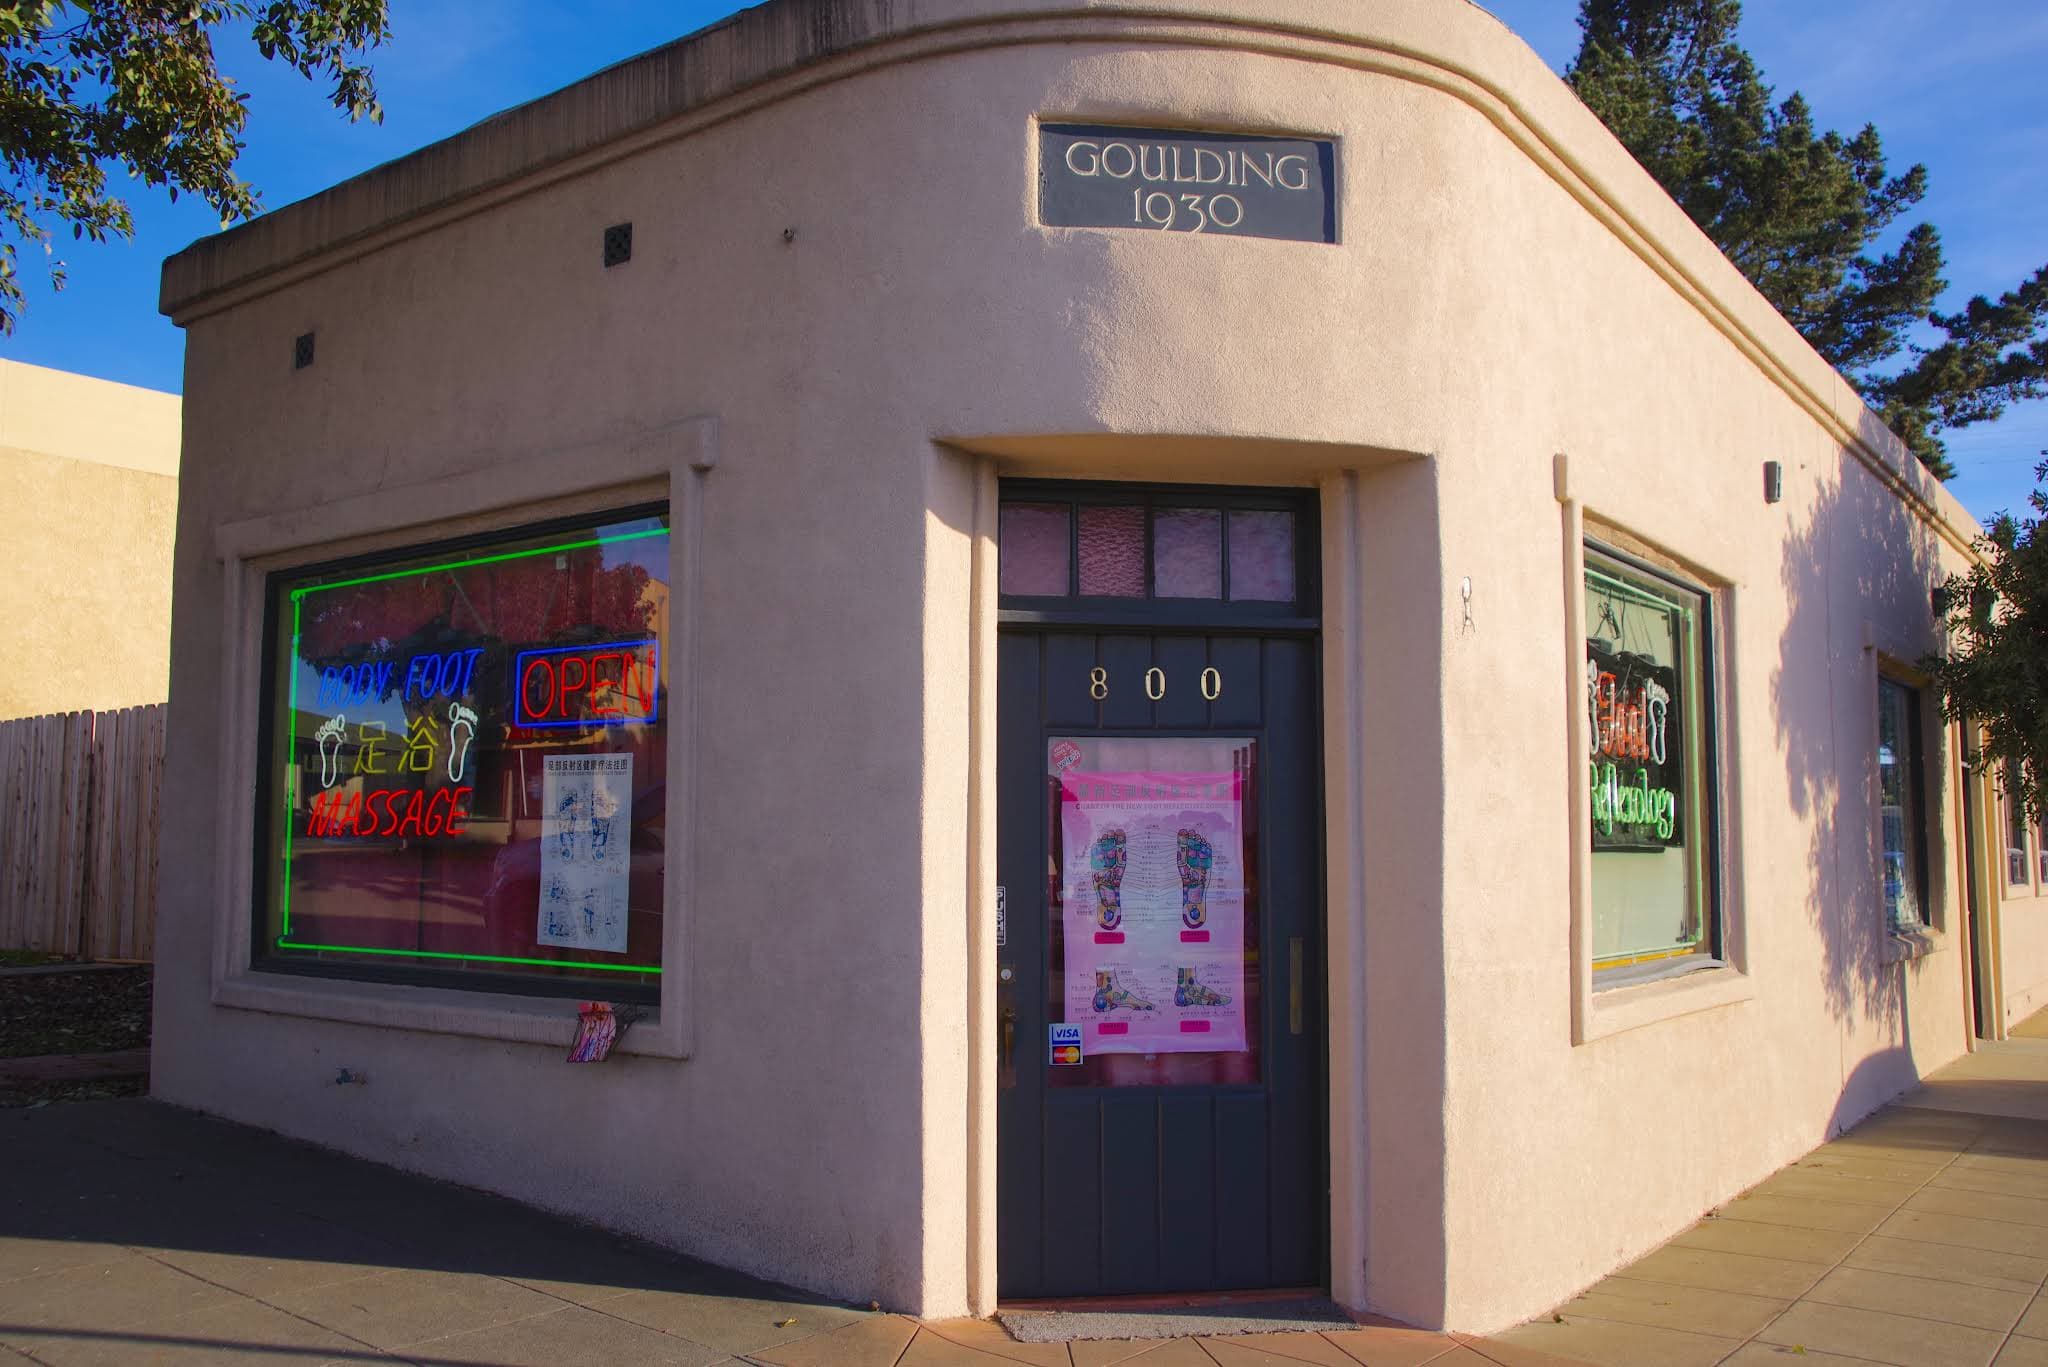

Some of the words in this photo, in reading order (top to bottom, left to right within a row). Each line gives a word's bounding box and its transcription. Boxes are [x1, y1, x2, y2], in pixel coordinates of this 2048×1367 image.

[1065, 141, 1310, 190] GOULDING
[1133, 187, 1245, 233] 1930
[317, 661, 394, 709] BODY
[404, 647, 485, 702] FOOT
[522, 651, 657, 719] OPEN
[1090, 666, 1221, 701] 800
[353, 716, 440, 775] 足浴
[306, 787, 474, 838] MASSAGE
[1056, 1028, 1079, 1038] VISA
